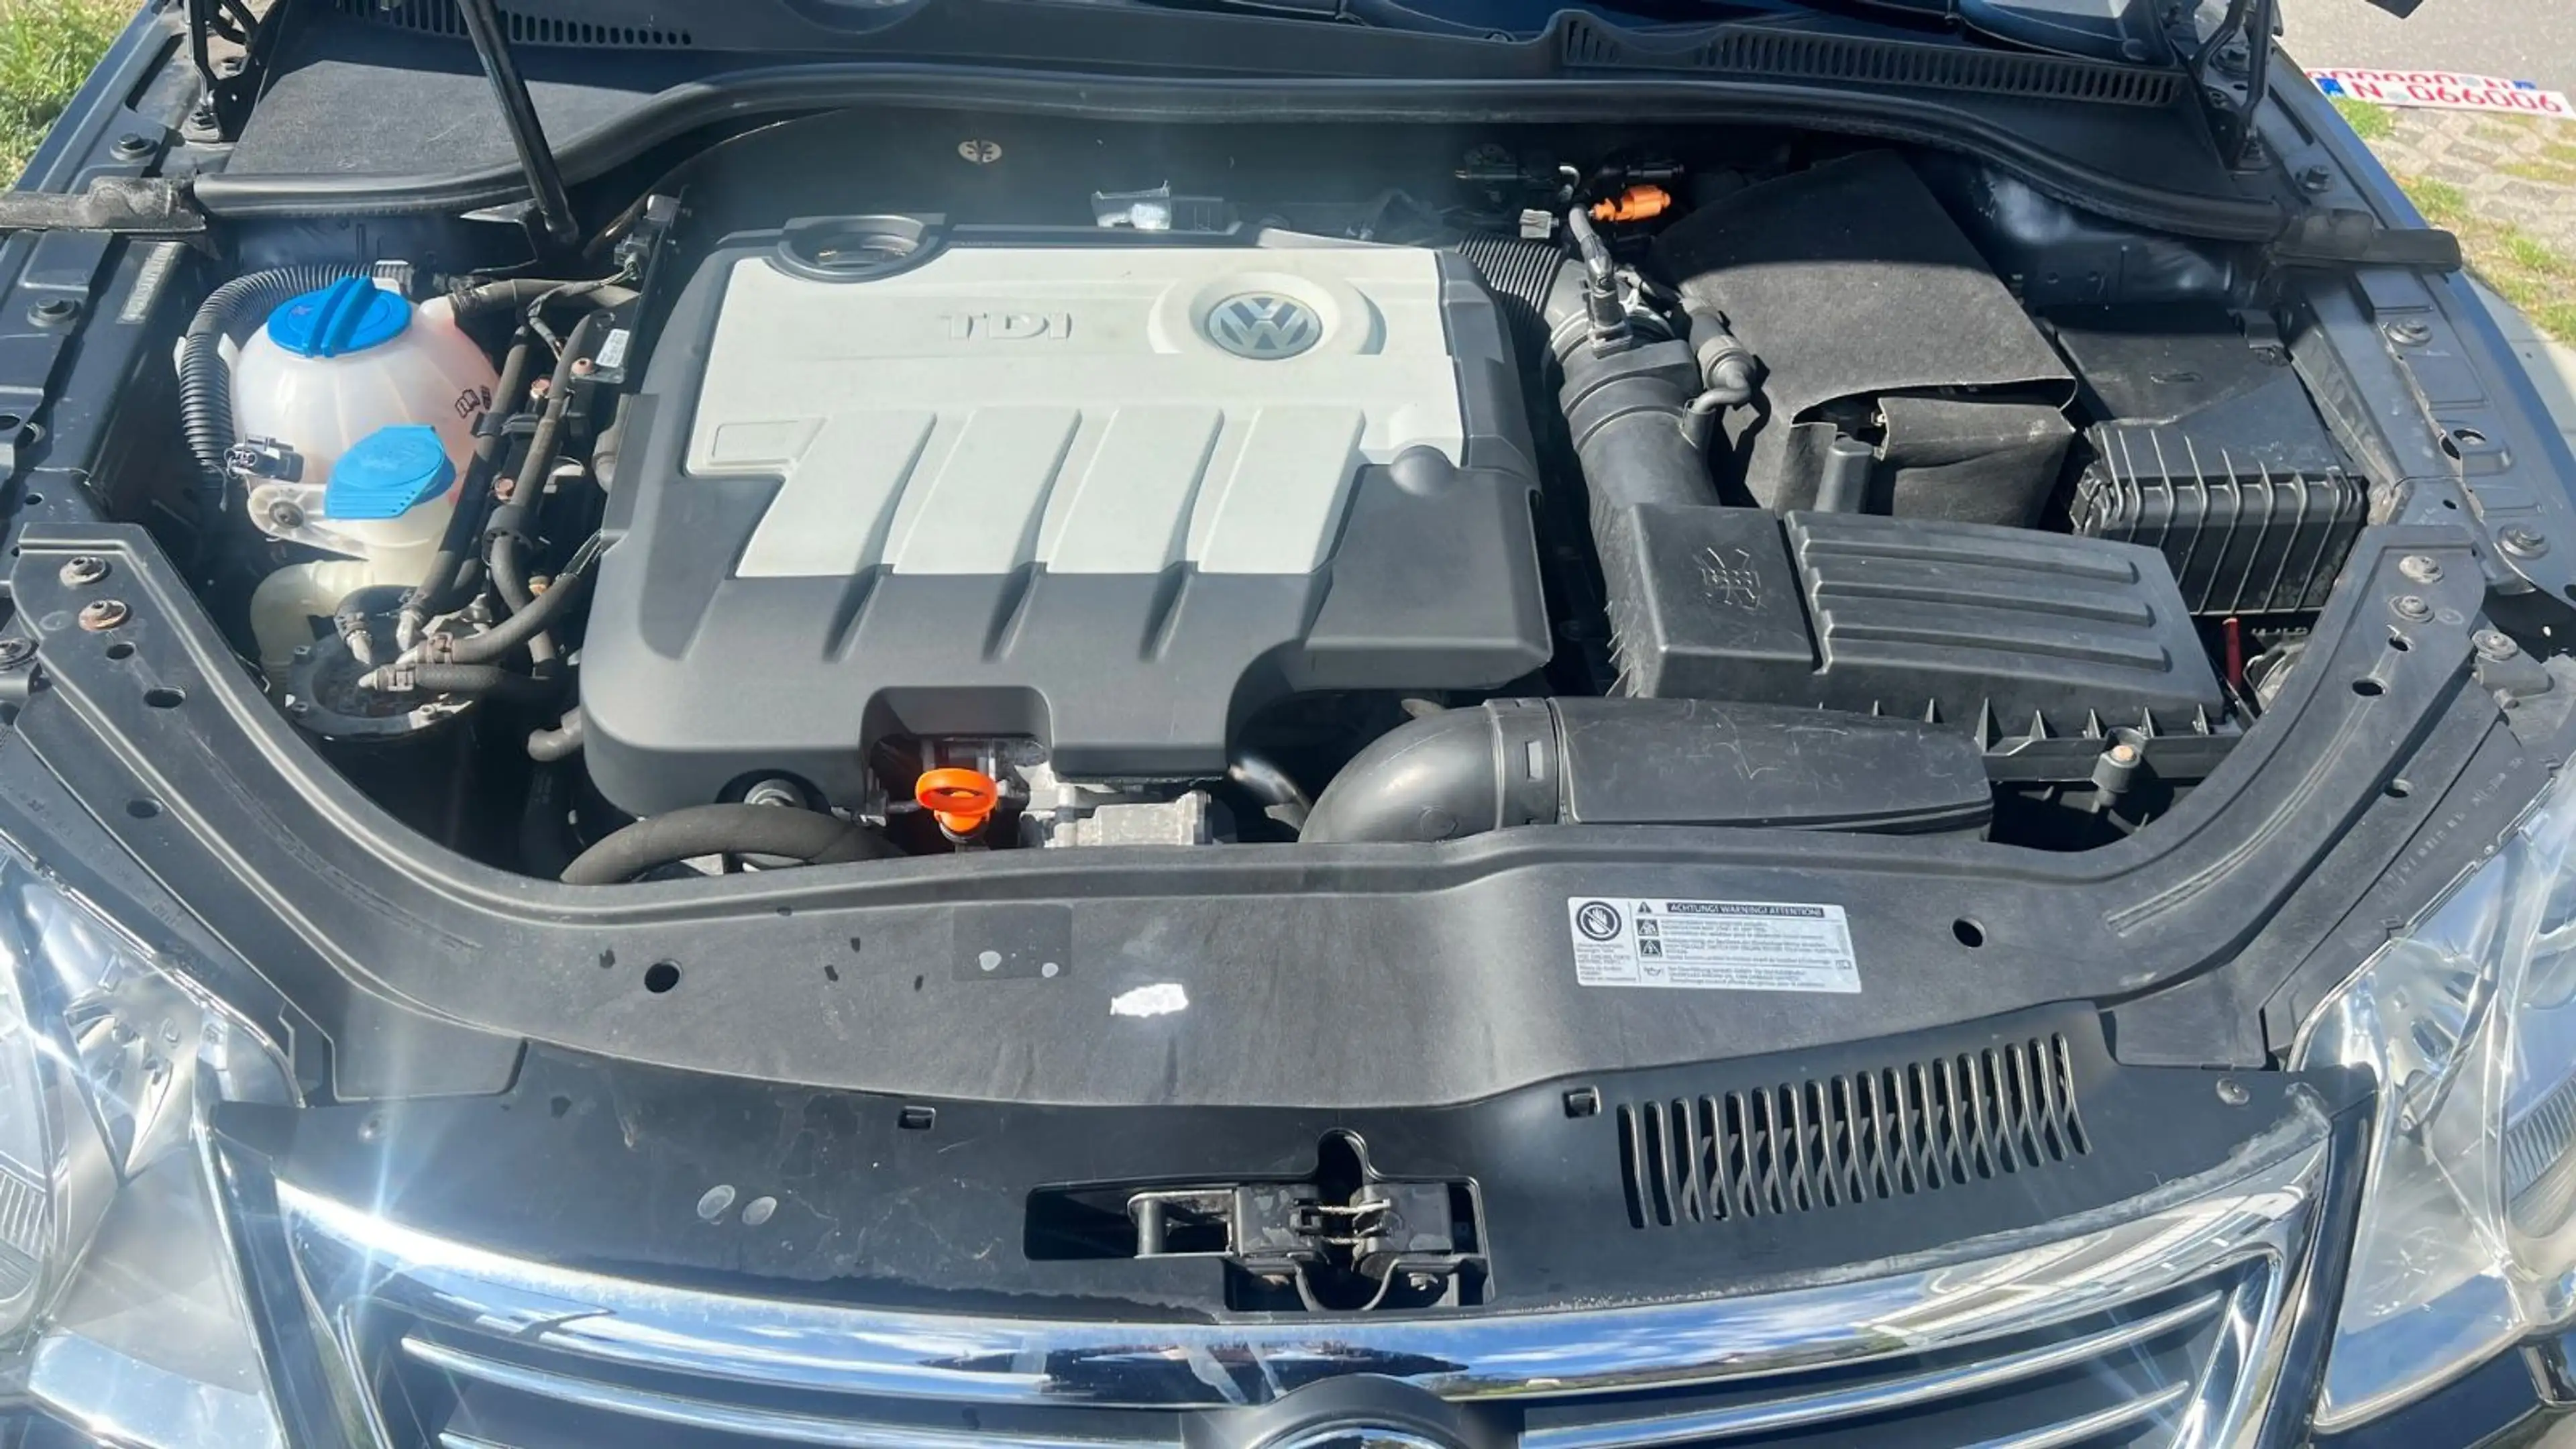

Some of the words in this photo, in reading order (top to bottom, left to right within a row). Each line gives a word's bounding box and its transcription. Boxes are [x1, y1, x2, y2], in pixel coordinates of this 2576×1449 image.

[2352, 81, 2383, 99] N
[2407, 85, 2563, 113] 066006
[939, 311, 1073, 341] TDI
